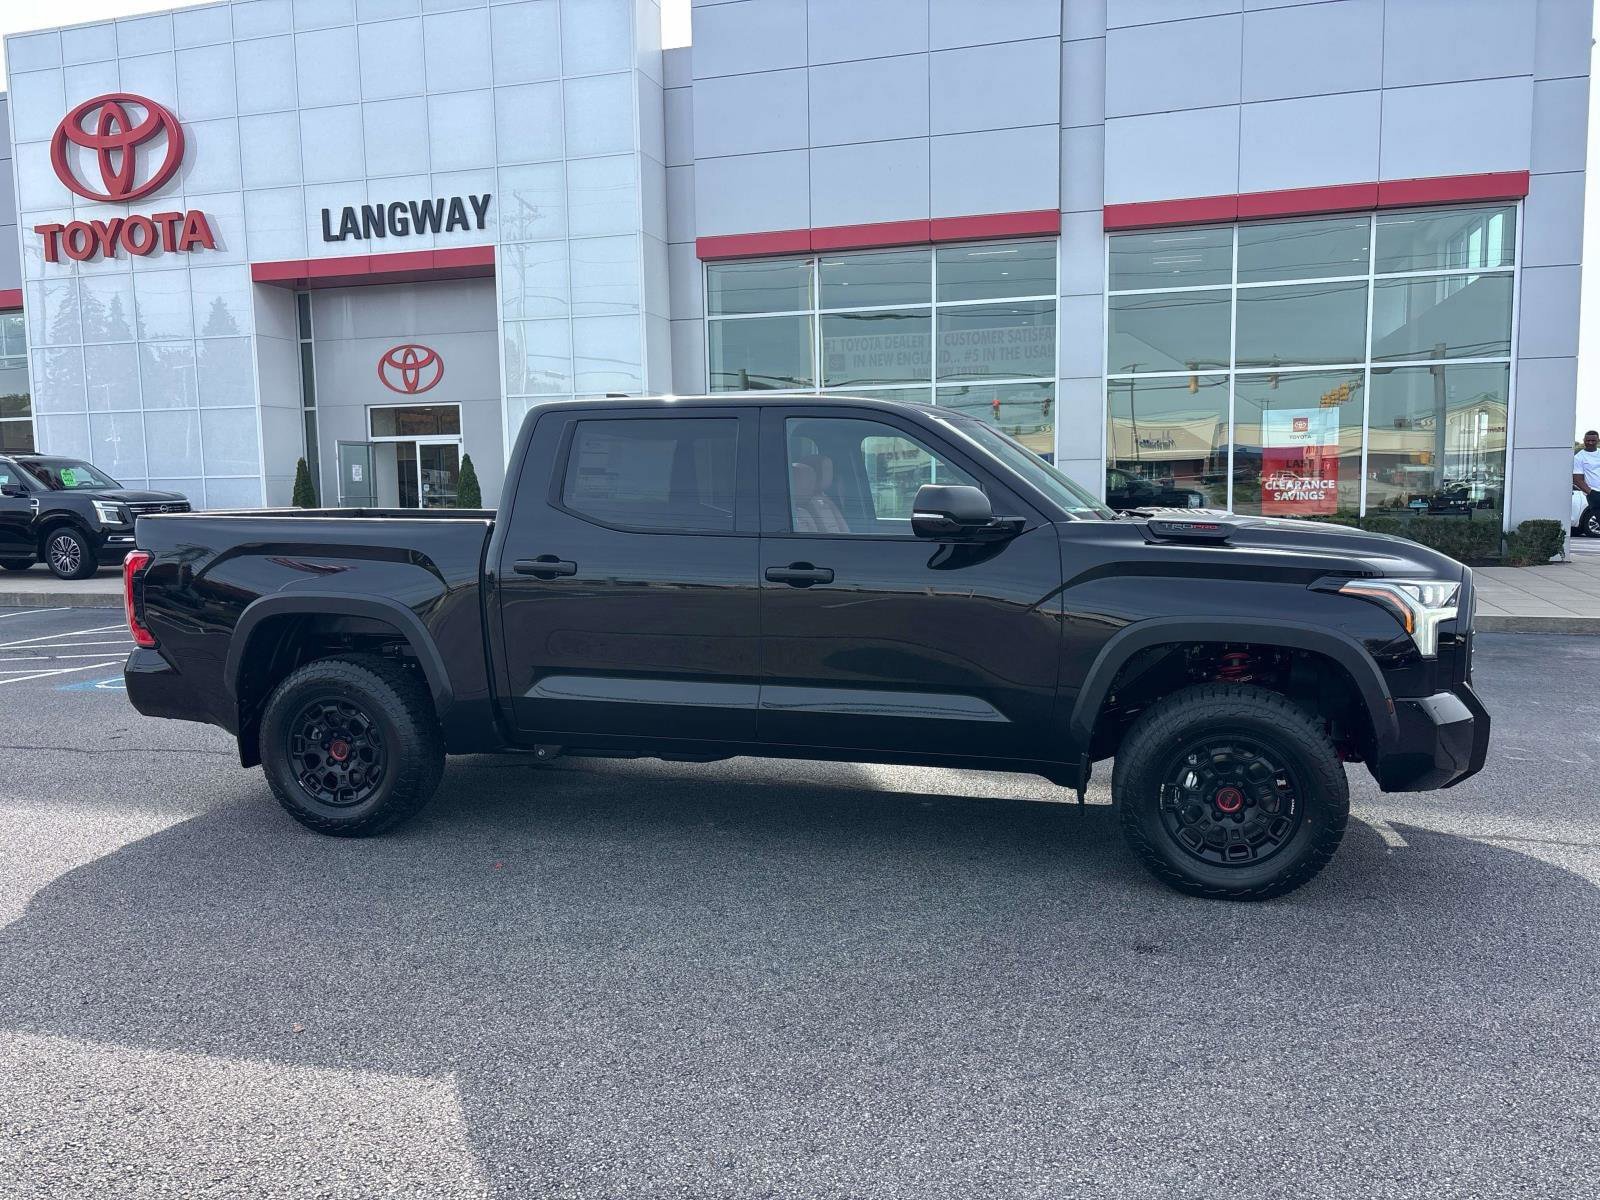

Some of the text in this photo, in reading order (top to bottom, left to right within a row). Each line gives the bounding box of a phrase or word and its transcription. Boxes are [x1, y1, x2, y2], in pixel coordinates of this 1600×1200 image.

[322, 194, 491, 242] LANGWAY
[34, 210, 217, 262] TOYOTA
[839, 335, 883, 353] TOYOTA
[885, 333, 924, 349] DEALER
[944, 330, 1004, 347] CUSTOMER
[853, 354, 865, 368] IN
[869, 351, 894, 367] NEW
[983, 347, 995, 361] IN
[999, 345, 1021, 360] THE
[1265, 480, 1336, 490] CLEARANCE
[1274, 491, 1326, 500] SAVINGS
